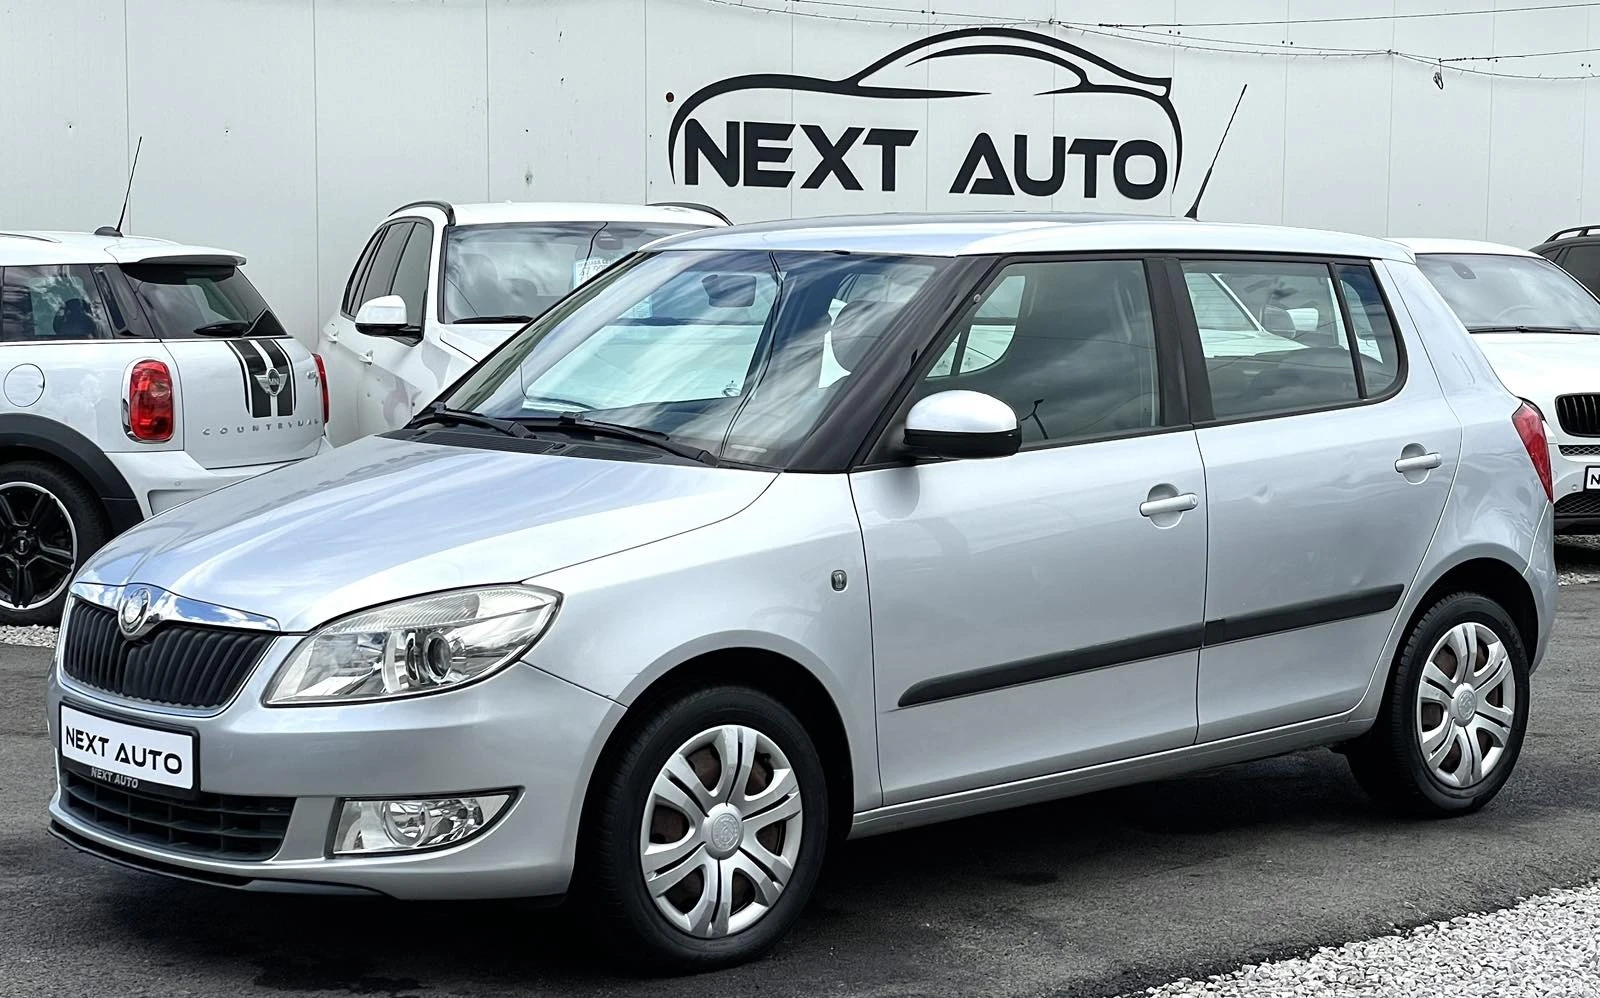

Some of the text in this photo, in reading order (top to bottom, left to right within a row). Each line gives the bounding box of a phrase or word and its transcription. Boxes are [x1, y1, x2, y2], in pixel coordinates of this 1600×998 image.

[684, 118, 1168, 200] NEXT AUTO
[66, 725, 182, 774] NEXT AUTO
[91, 767, 139, 789] NEXT AUTO
